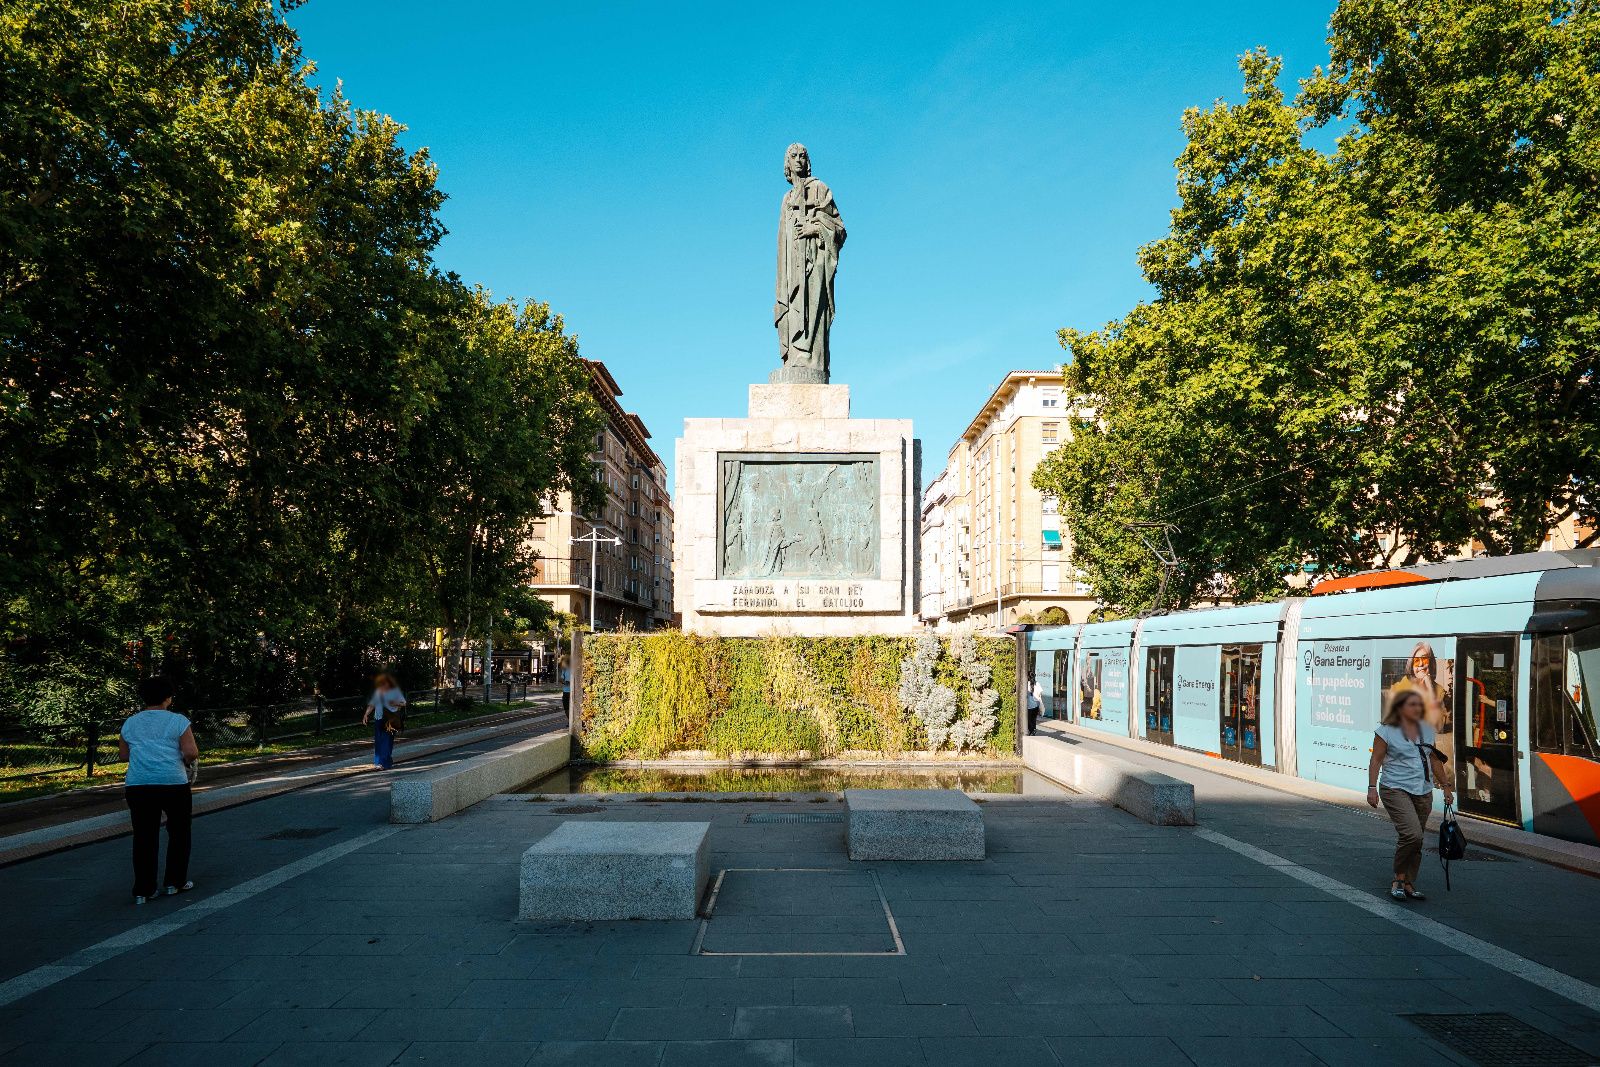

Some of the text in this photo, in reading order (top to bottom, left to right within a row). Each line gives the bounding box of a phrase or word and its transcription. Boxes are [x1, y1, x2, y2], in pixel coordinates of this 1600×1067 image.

[784, 586, 789, 595] A
[800, 586, 810, 595] SU
[819, 586, 840, 595] GRAN
[848, 586, 863, 596] REY
[733, 598, 778, 608] FERNANDO
[796, 598, 806, 608] EL
[1314, 655, 1370, 670] Gana Energía
[1306, 673, 1365, 690] sin papeleos
[1318, 694, 1351, 706] y en un
[1316, 709, 1354, 724] solo día.
